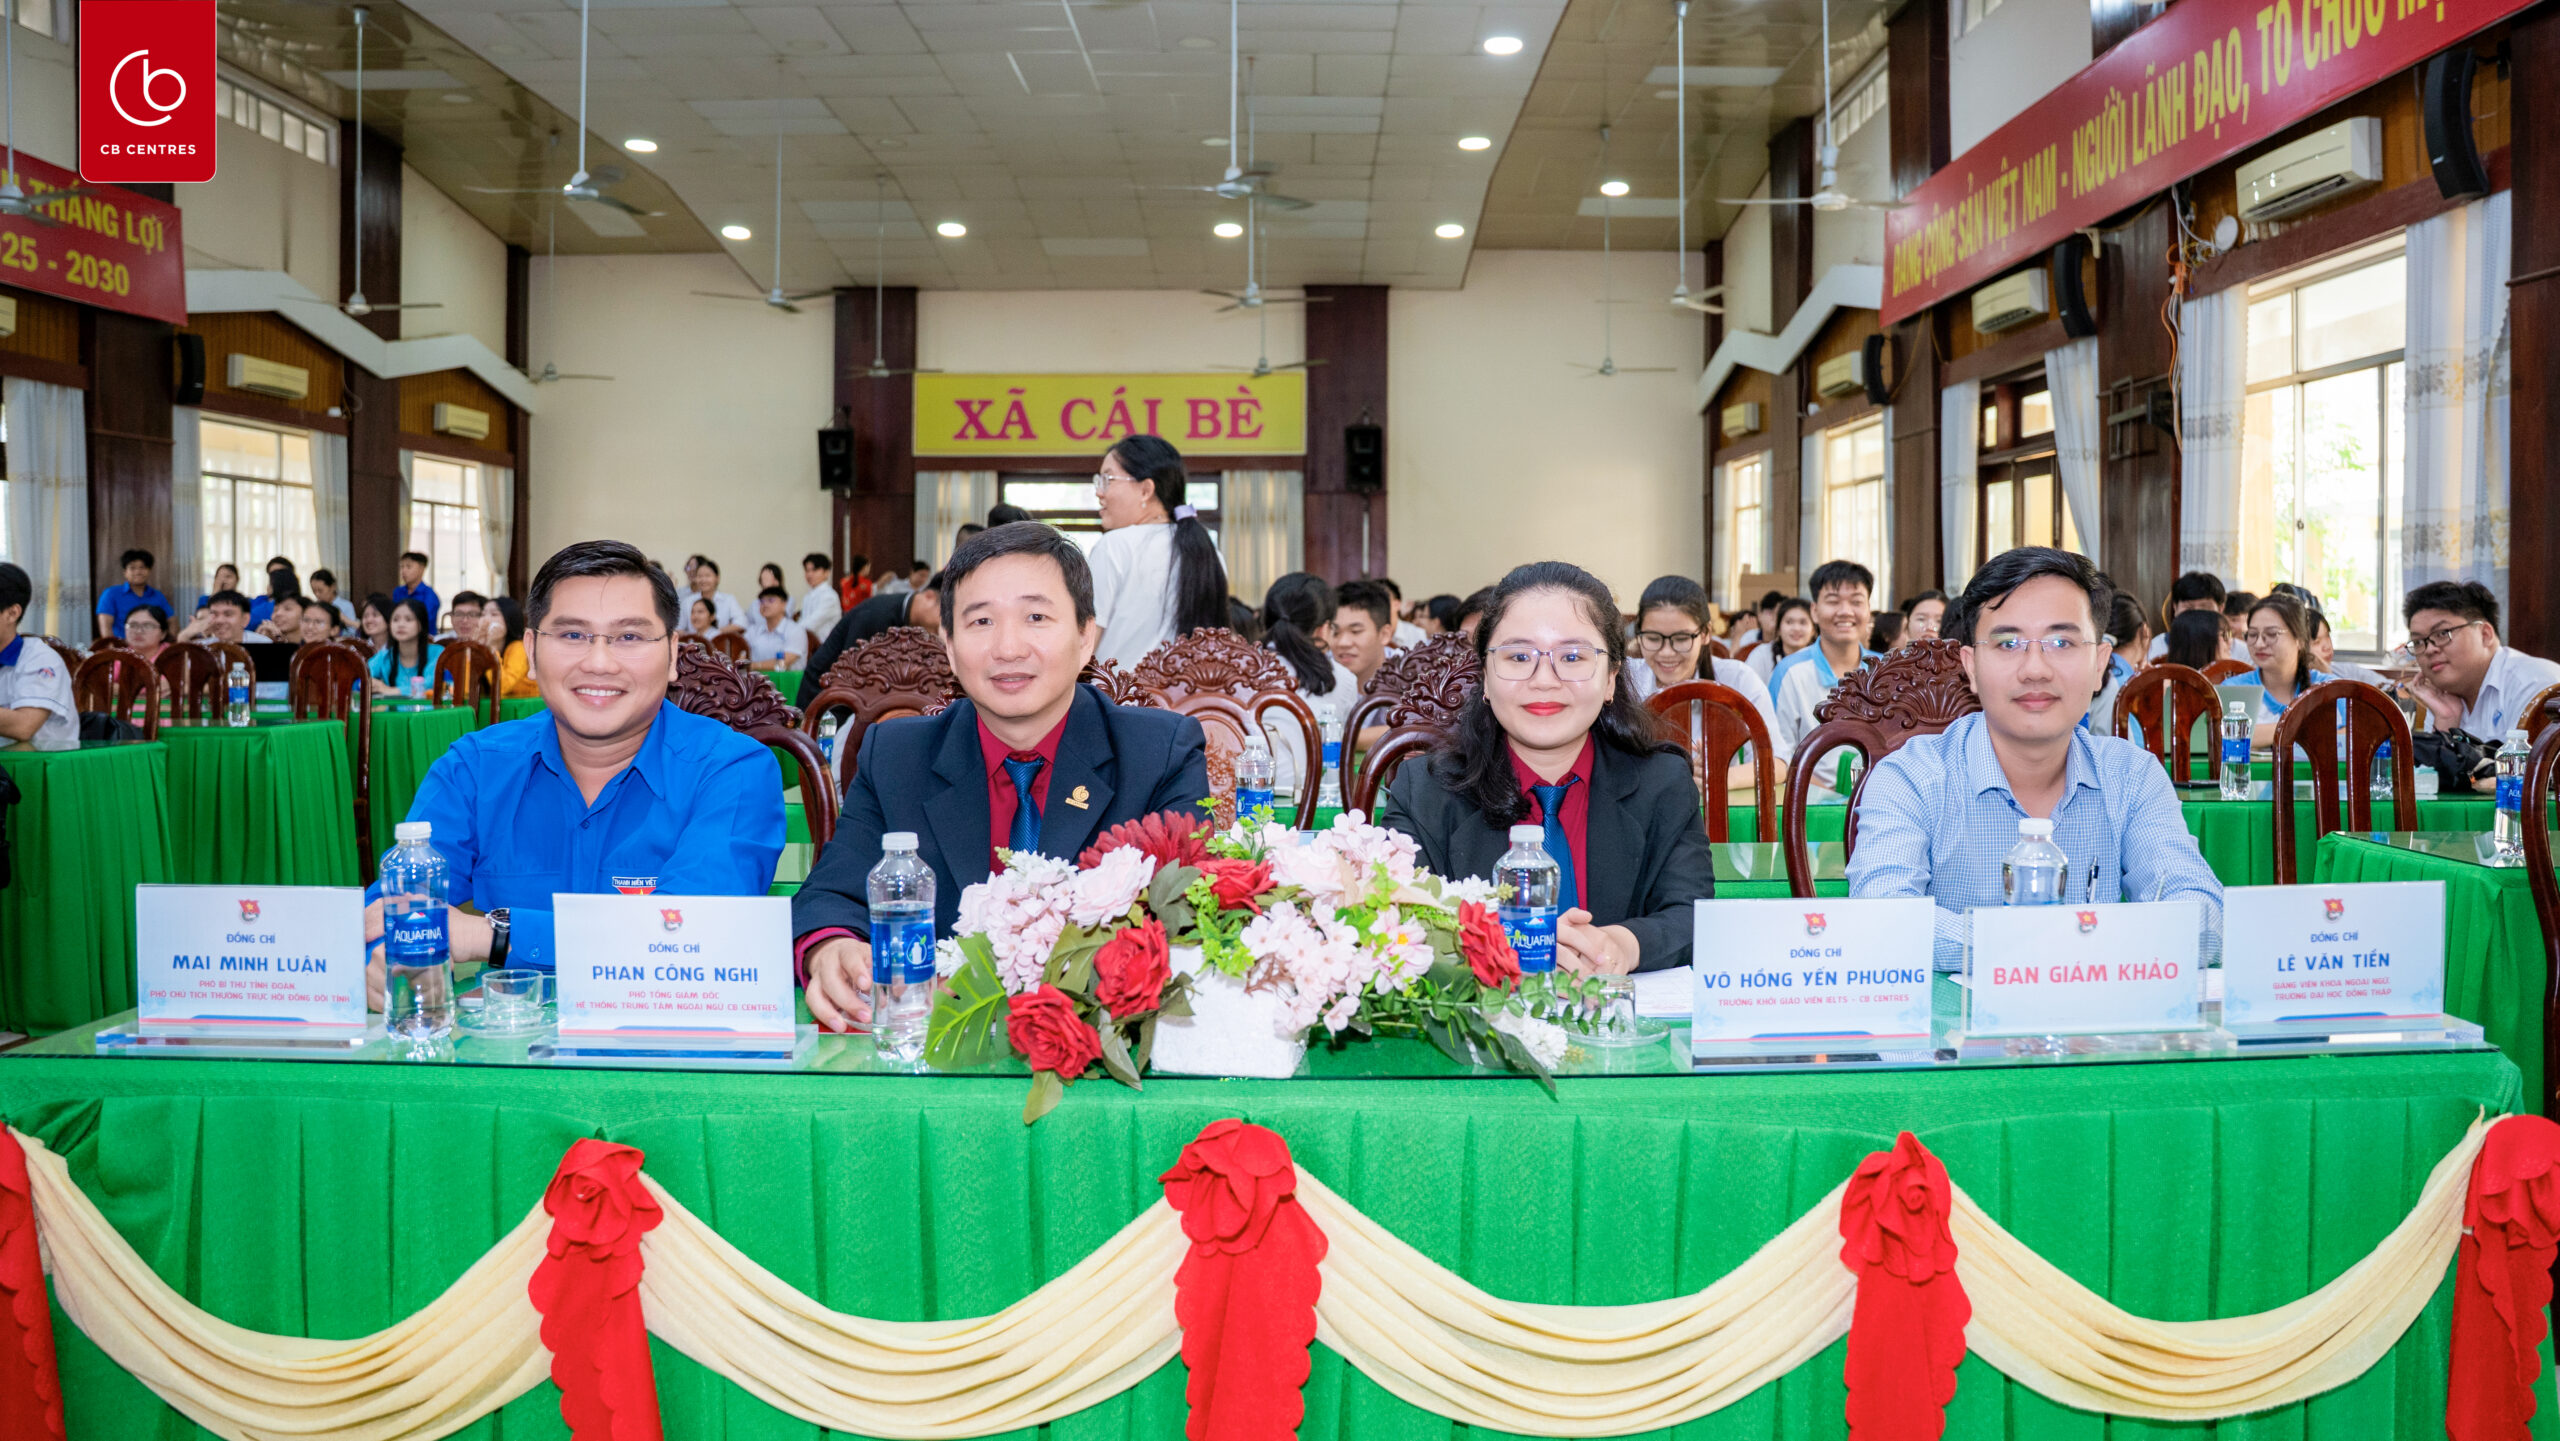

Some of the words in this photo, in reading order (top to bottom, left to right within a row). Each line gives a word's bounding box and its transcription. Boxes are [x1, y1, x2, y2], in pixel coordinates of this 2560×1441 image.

[1986, 157, 2019, 250] VIỆT
[2023, 144, 2057, 226] NAM
[2073, 86, 2126, 199] NGƯỜI
[2132, 61, 2186, 166] LÃNH
[2194, 27, 2250, 140] ĐẠO,
[125, 210, 165, 255] LỢI
[0, 231, 38, 272] 25
[66, 250, 130, 297] 2030
[952, 388, 1037, 441] XÃ
[1060, 386, 1164, 441] CÁI
[1184, 385, 1264, 440] BÈ
[393, 926, 443, 944] AQUAFINA
[172, 954, 211, 970] MAI
[220, 956, 268, 971] MINH
[277, 955, 327, 976] LUẬN
[1992, 966, 2039, 985] BAN
[2049, 961, 2108, 983] GIÁM
[2118, 957, 2179, 981] KHẢO
[2277, 954, 2296, 972] LÊ
[2305, 953, 2344, 971] VĂN
[592, 965, 645, 981] PHAN
[654, 964, 705, 982] CÔNG
[714, 967, 758, 986] NGHỊ
[1803, 966, 1838, 987] YẾN
[742, 1003, 778, 1012] CENTRES
[1873, 994, 1910, 1003] CENTRES
